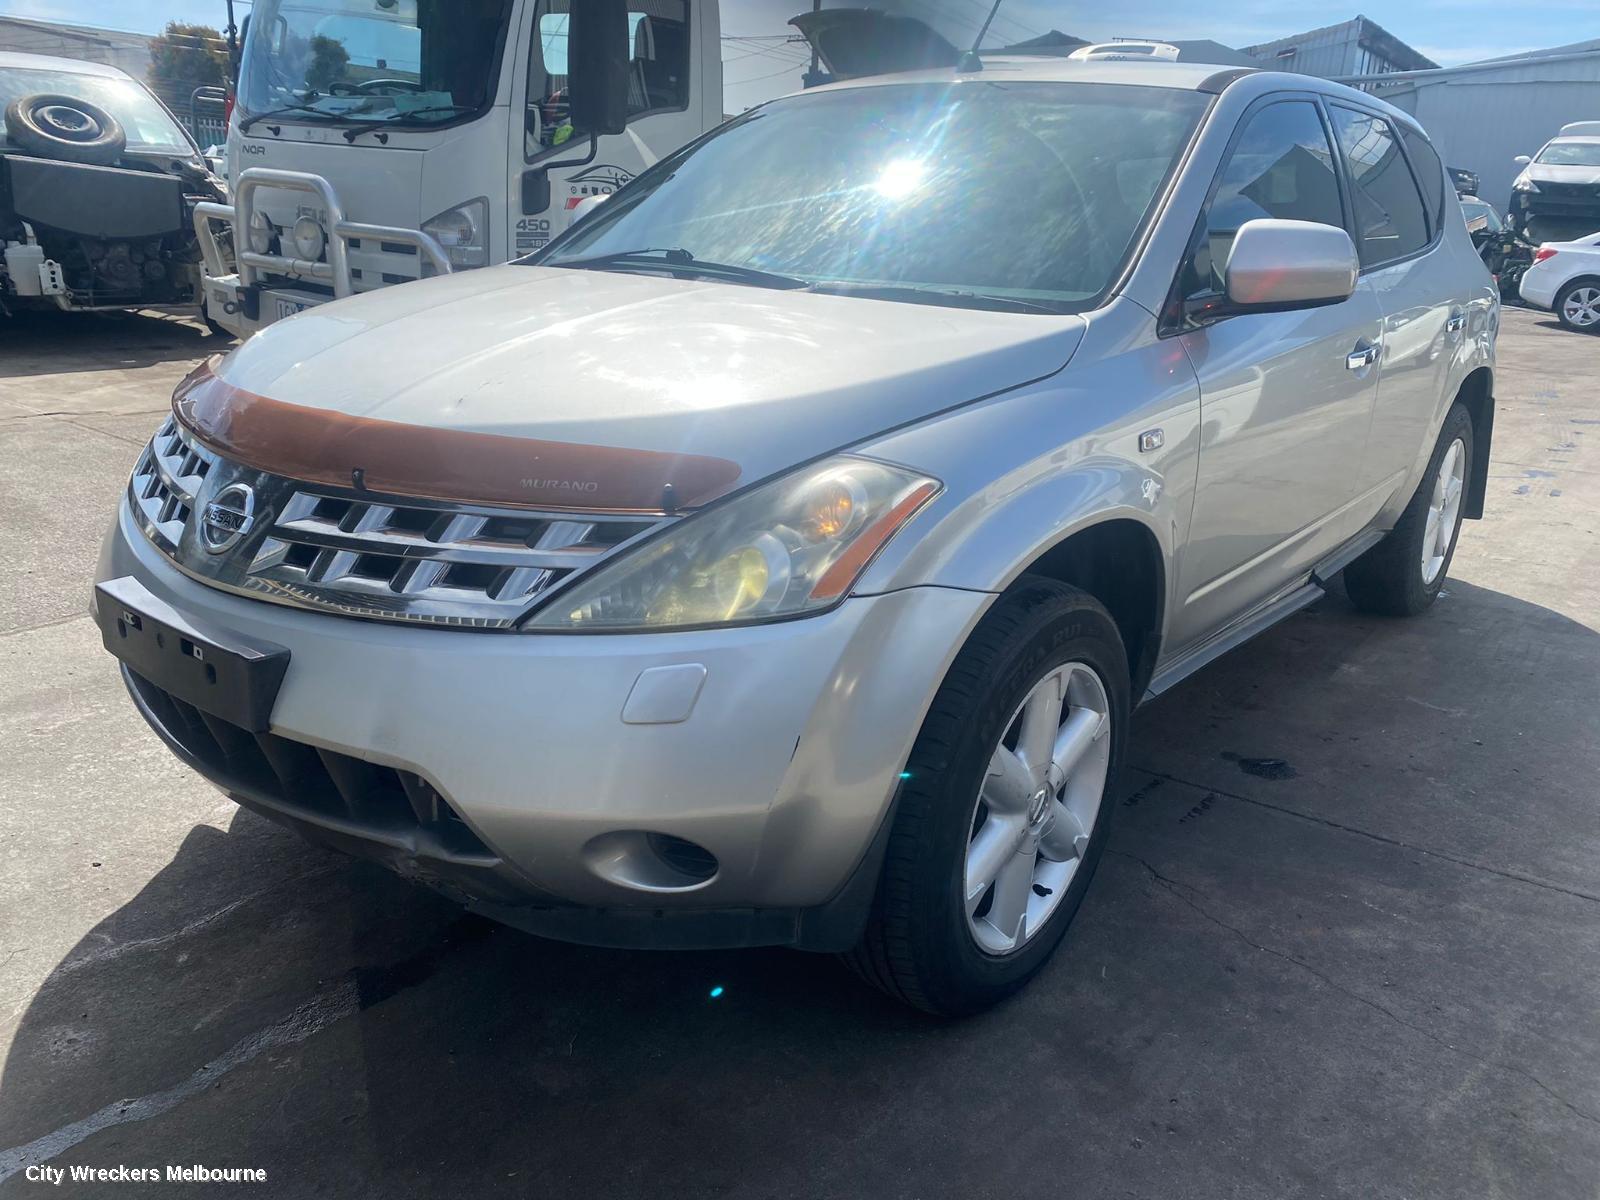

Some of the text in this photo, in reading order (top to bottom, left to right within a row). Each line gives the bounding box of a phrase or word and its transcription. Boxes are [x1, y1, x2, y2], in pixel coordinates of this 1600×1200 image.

[242, 145, 266, 155] NQR
[516, 219, 550, 231] 450
[520, 478, 598, 493] MURANO
